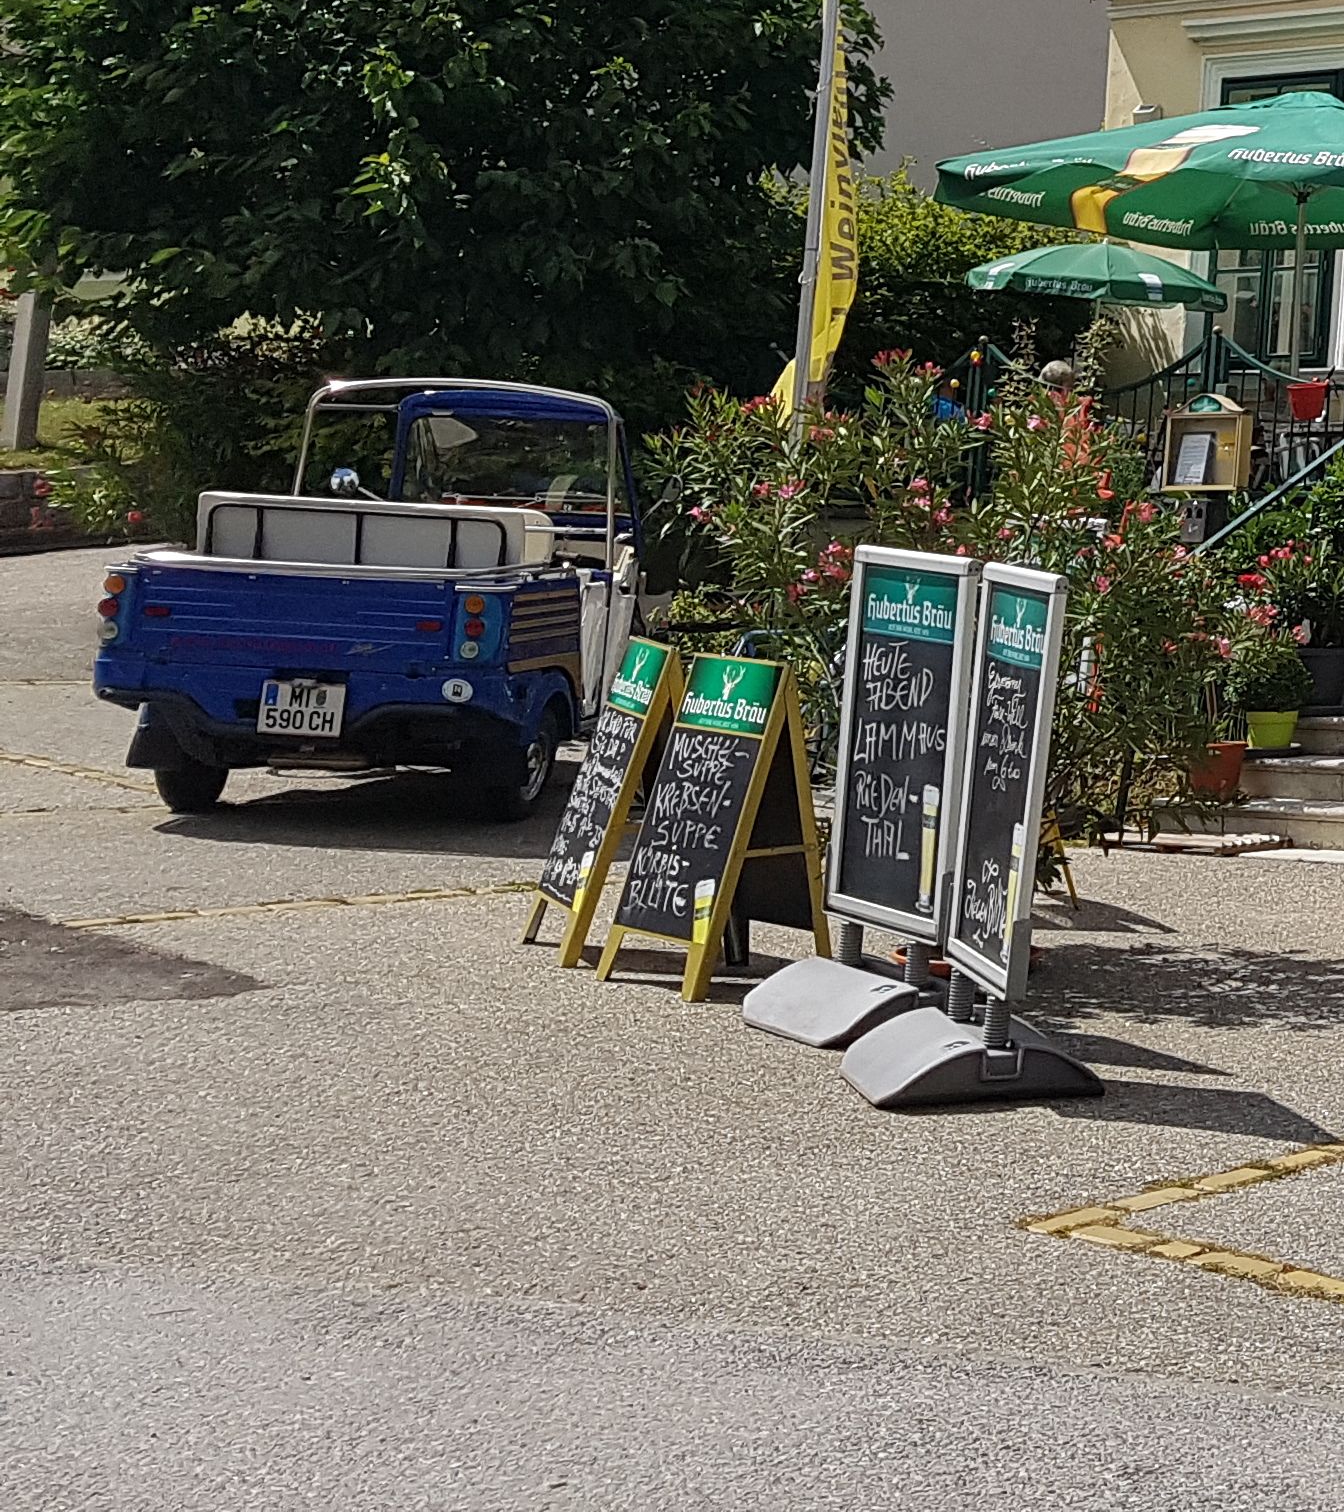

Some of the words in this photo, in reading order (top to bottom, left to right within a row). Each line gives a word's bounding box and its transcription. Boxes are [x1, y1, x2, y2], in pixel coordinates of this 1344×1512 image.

[1228, 148, 1313, 165] Hubertus
[867, 592, 920, 624] Hubertus
[921, 600, 953, 630] Bräu
[863, 641, 912, 680] HEUTE
[289, 689, 311, 708] MI
[866, 668, 934, 711] ABEND
[265, 708, 304, 730] 590
[308, 710, 335, 733] CH
[682, 691, 735, 718] Hubertus
[734, 698, 768, 724] Bräu
[652, 821, 722, 850] SUPPE
